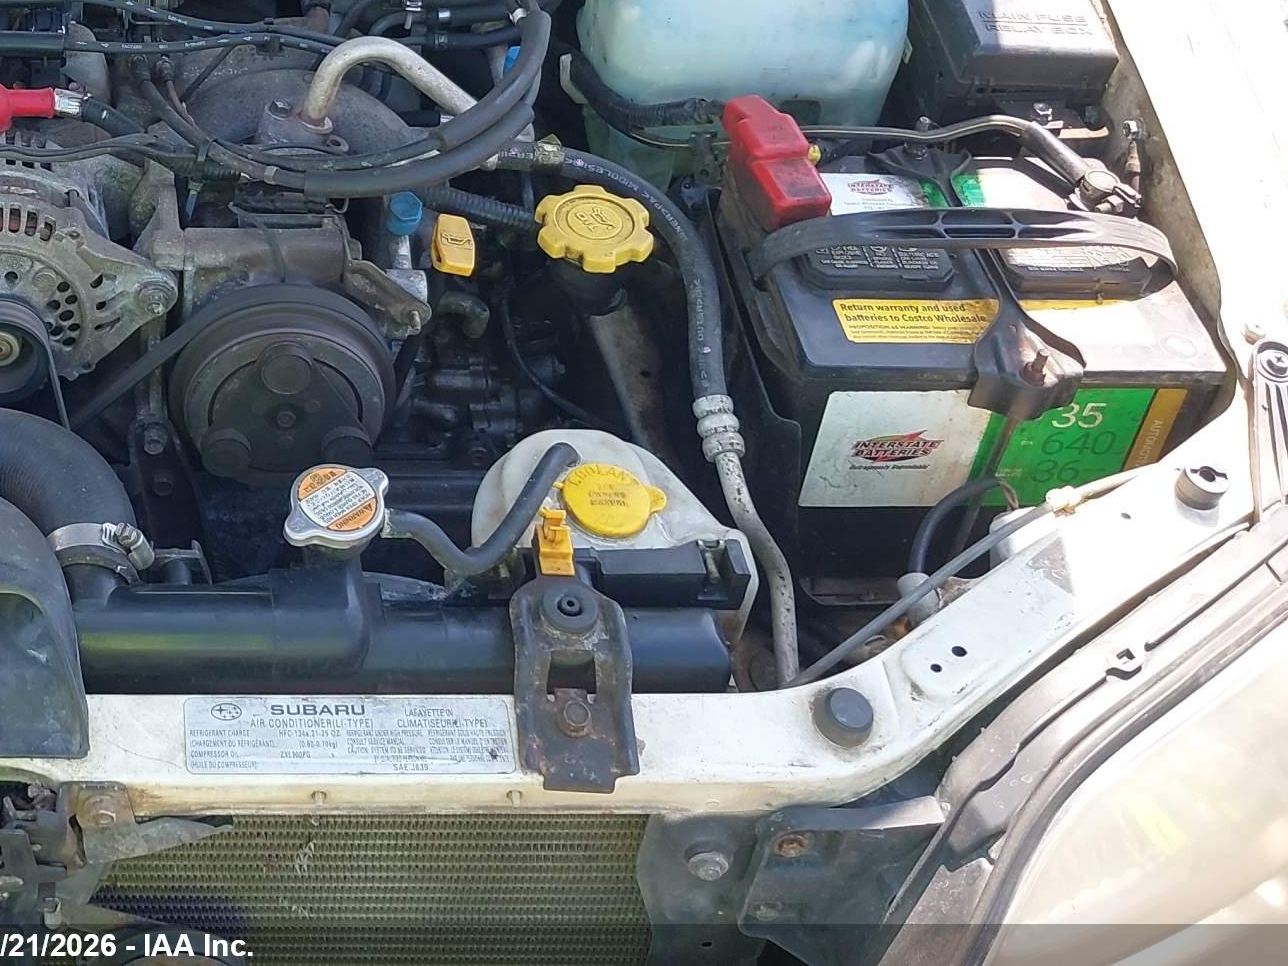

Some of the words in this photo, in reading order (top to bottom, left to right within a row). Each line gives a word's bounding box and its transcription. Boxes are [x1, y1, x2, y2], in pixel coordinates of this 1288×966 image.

[840, 303, 873, 311] Return
[876, 304, 919, 313] warranty
[922, 304, 940, 312] and
[943, 304, 966, 312] used
[845, 313, 888, 322] batteries
[902, 314, 934, 322] Costco
[935, 314, 987, 323] Wholesale
[1052, 402, 1107, 428] 35
[853, 440, 938, 449] INTERSTATE
[1041, 430, 1117, 456] 640
[854, 448, 931, 457] BATTERIES
[270, 704, 366, 716] SUBARU
[404, 708, 446, 717] LAFAYETTE
[250, 718, 266, 728] AIR
[190, 729, 226, 737] REFRIGERANT
[227, 729, 250, 737] CHARGE
[190, 750, 229, 758] COMPRESSOR
[393, 763, 408, 771] SAE
